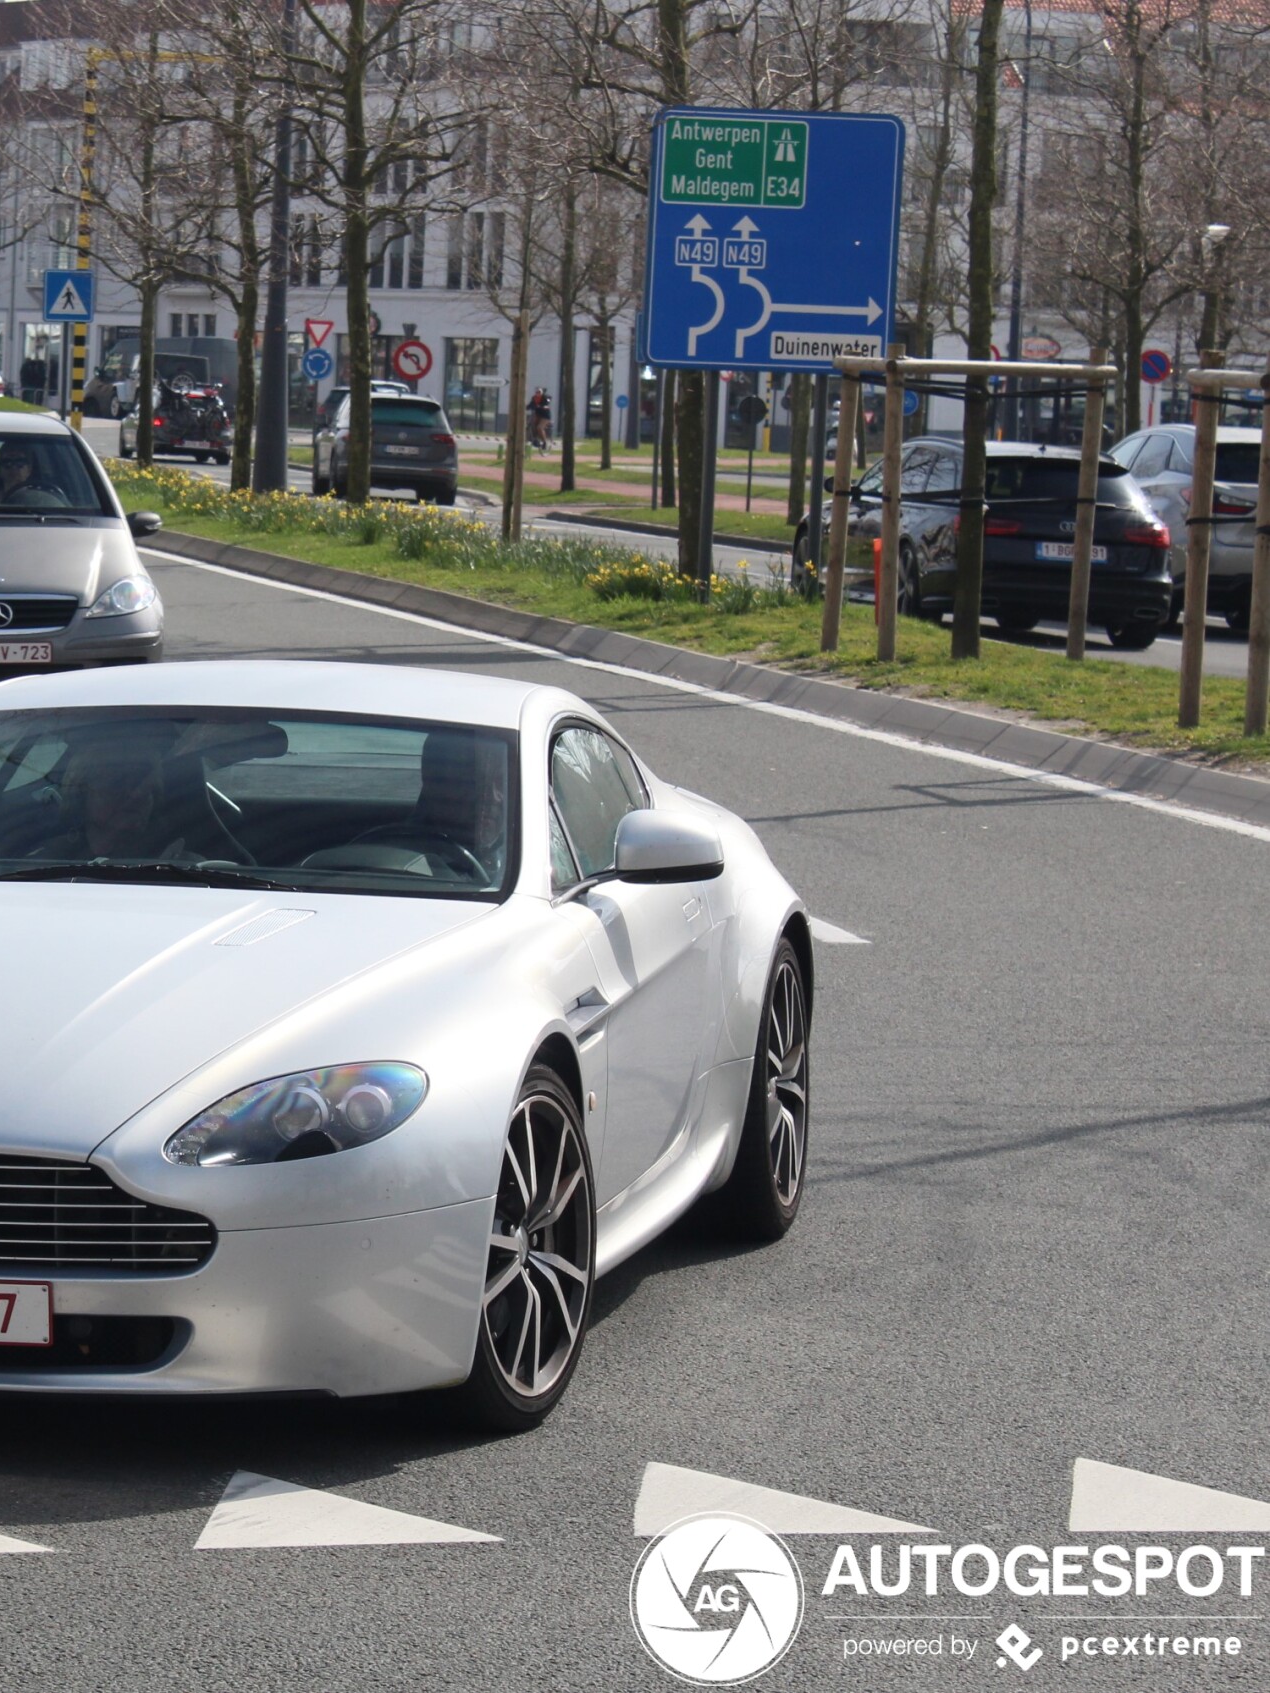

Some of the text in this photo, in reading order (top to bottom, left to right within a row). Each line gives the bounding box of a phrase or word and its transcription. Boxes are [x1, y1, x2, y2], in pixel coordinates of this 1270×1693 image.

[671, 120, 761, 147] Antwerpen
[695, 149, 733, 170] Gent
[671, 174, 755, 202] Maldegem
[766, 176, 801, 198] E34
[679, 242, 714, 263] N49
[727, 243, 762, 264] N49
